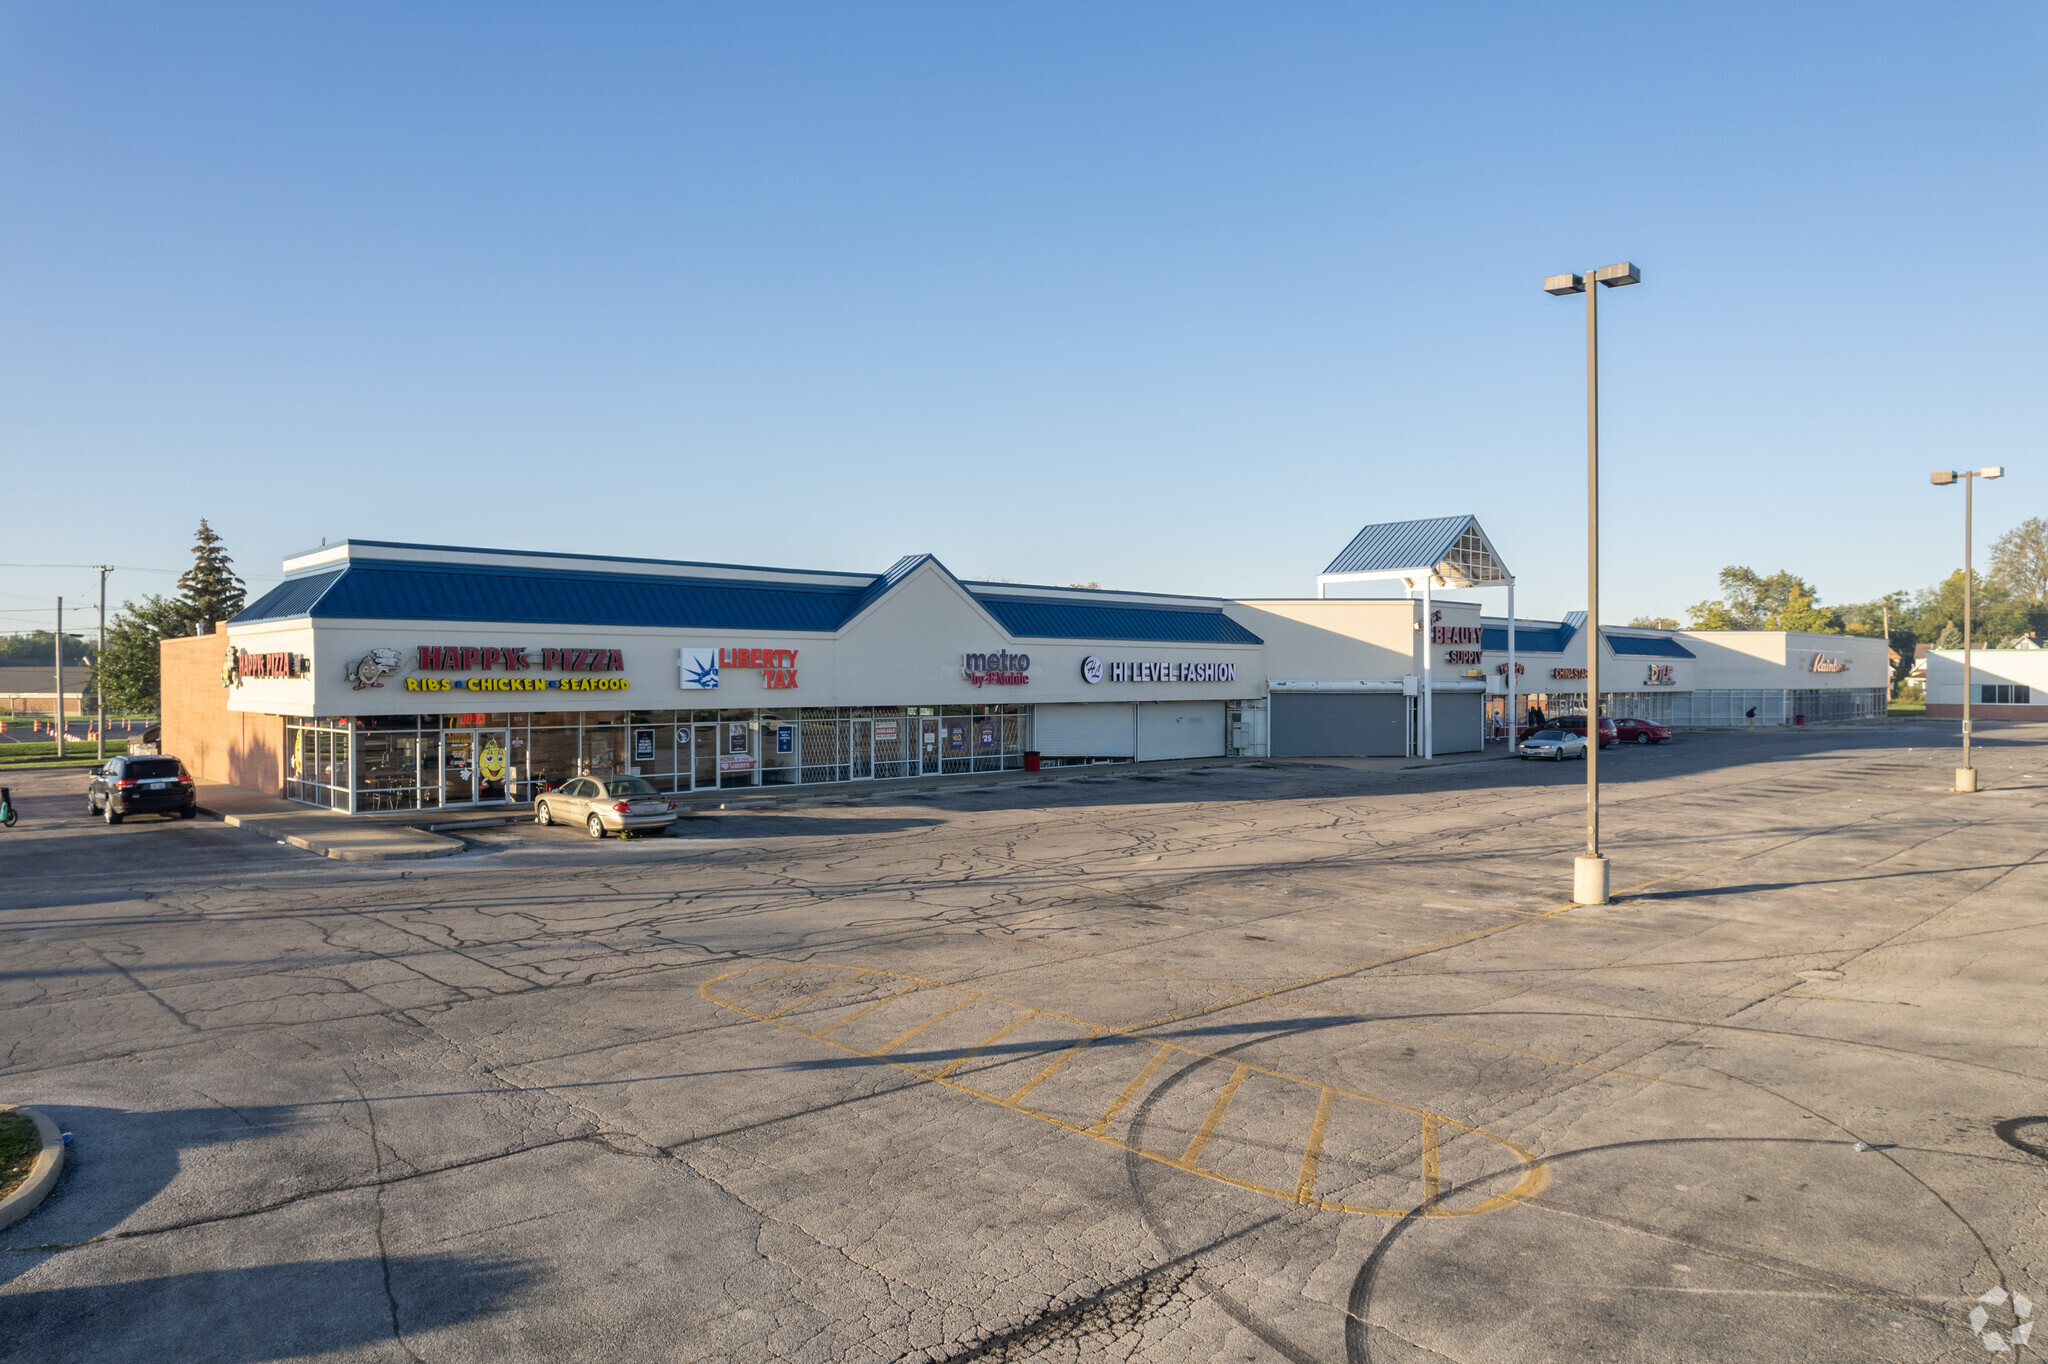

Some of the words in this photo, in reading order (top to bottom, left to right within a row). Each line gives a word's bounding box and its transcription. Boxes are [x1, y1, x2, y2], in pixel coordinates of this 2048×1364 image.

[1434, 626, 1483, 644] BEAUTY
[266, 652, 291, 677] PIZZA
[541, 648, 624, 671] PIZZA
[719, 648, 798, 669] LIBERTY
[965, 648, 1030, 672] metro
[1450, 650, 1483, 664] SUPPLY
[762, 669, 798, 689] TAX
[971, 672, 984, 688] by
[1111, 662, 1128, 682] HI
[1132, 662, 1177, 682] LEVEL
[1180, 662, 1236, 682] FASHION
[1554, 668, 1573, 679] CHINA
[1649, 664, 1674, 681] DTLR
[406, 677, 450, 692] RIBS
[467, 677, 546, 692] CHICKEN
[559, 677, 630, 692] SEAFOOD
[461, 713, 486, 725] OPEN
